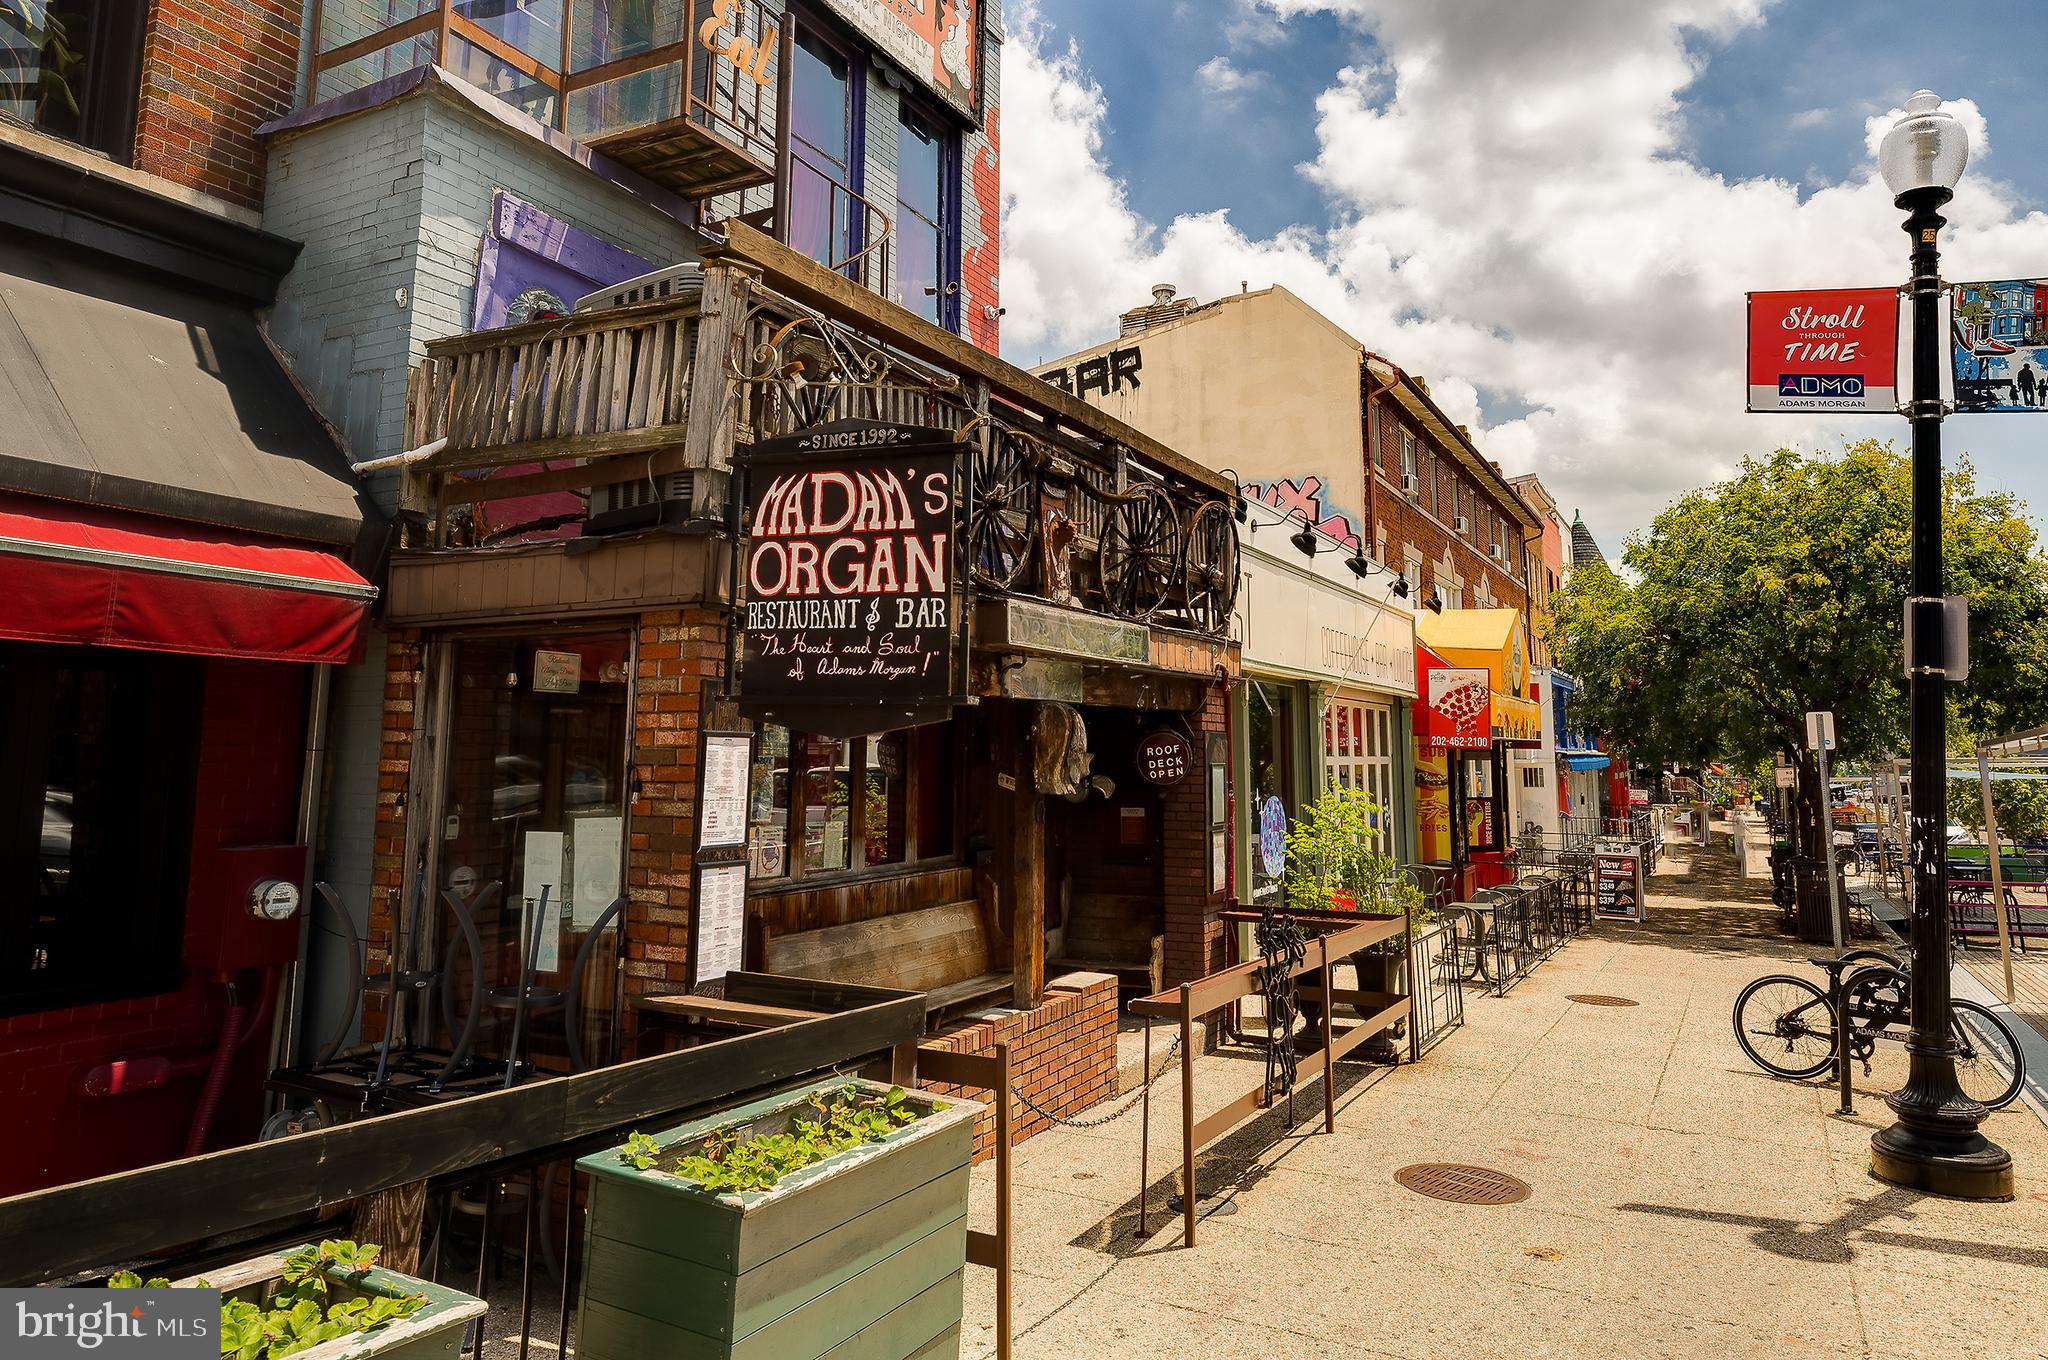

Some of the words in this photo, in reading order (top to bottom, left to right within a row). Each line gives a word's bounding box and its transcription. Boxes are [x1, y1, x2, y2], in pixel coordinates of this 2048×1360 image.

[897, 1, 913, 20] BAR
[883, 8, 929, 58] NIGHTLY
[1922, 230, 1935, 242] 25
[1780, 304, 1865, 332] Stroll
[1784, 341, 1860, 363] TIME
[1781, 376, 1862, 395] ADMO
[1778, 400, 1815, 408] ADAMS
[1818, 400, 1866, 408] MORGAN
[812, 432, 857, 449] SINCE
[860, 428, 898, 446] 1992
[751, 467, 948, 537] MADAM'S
[750, 534, 947, 597] ORGAN
[747, 599, 861, 630] RESTAURANT
[895, 597, 947, 629] BAR
[788, 632, 834, 655] Heart
[842, 635, 872, 655] and
[878, 632, 921, 656] Soul
[787, 657, 804, 681] of
[817, 657, 865, 676] Adams
[1146, 744, 1180, 756] ROOF
[1431, 736, 1488, 747] 202-462-2100
[1148, 756, 1183, 769] DECK
[1150, 767, 1184, 779] OPEN
[1420, 824, 1448, 832] FRIES
[1599, 859, 1620, 869] New
[1855, 1027, 1886, 1039] ADAMS
